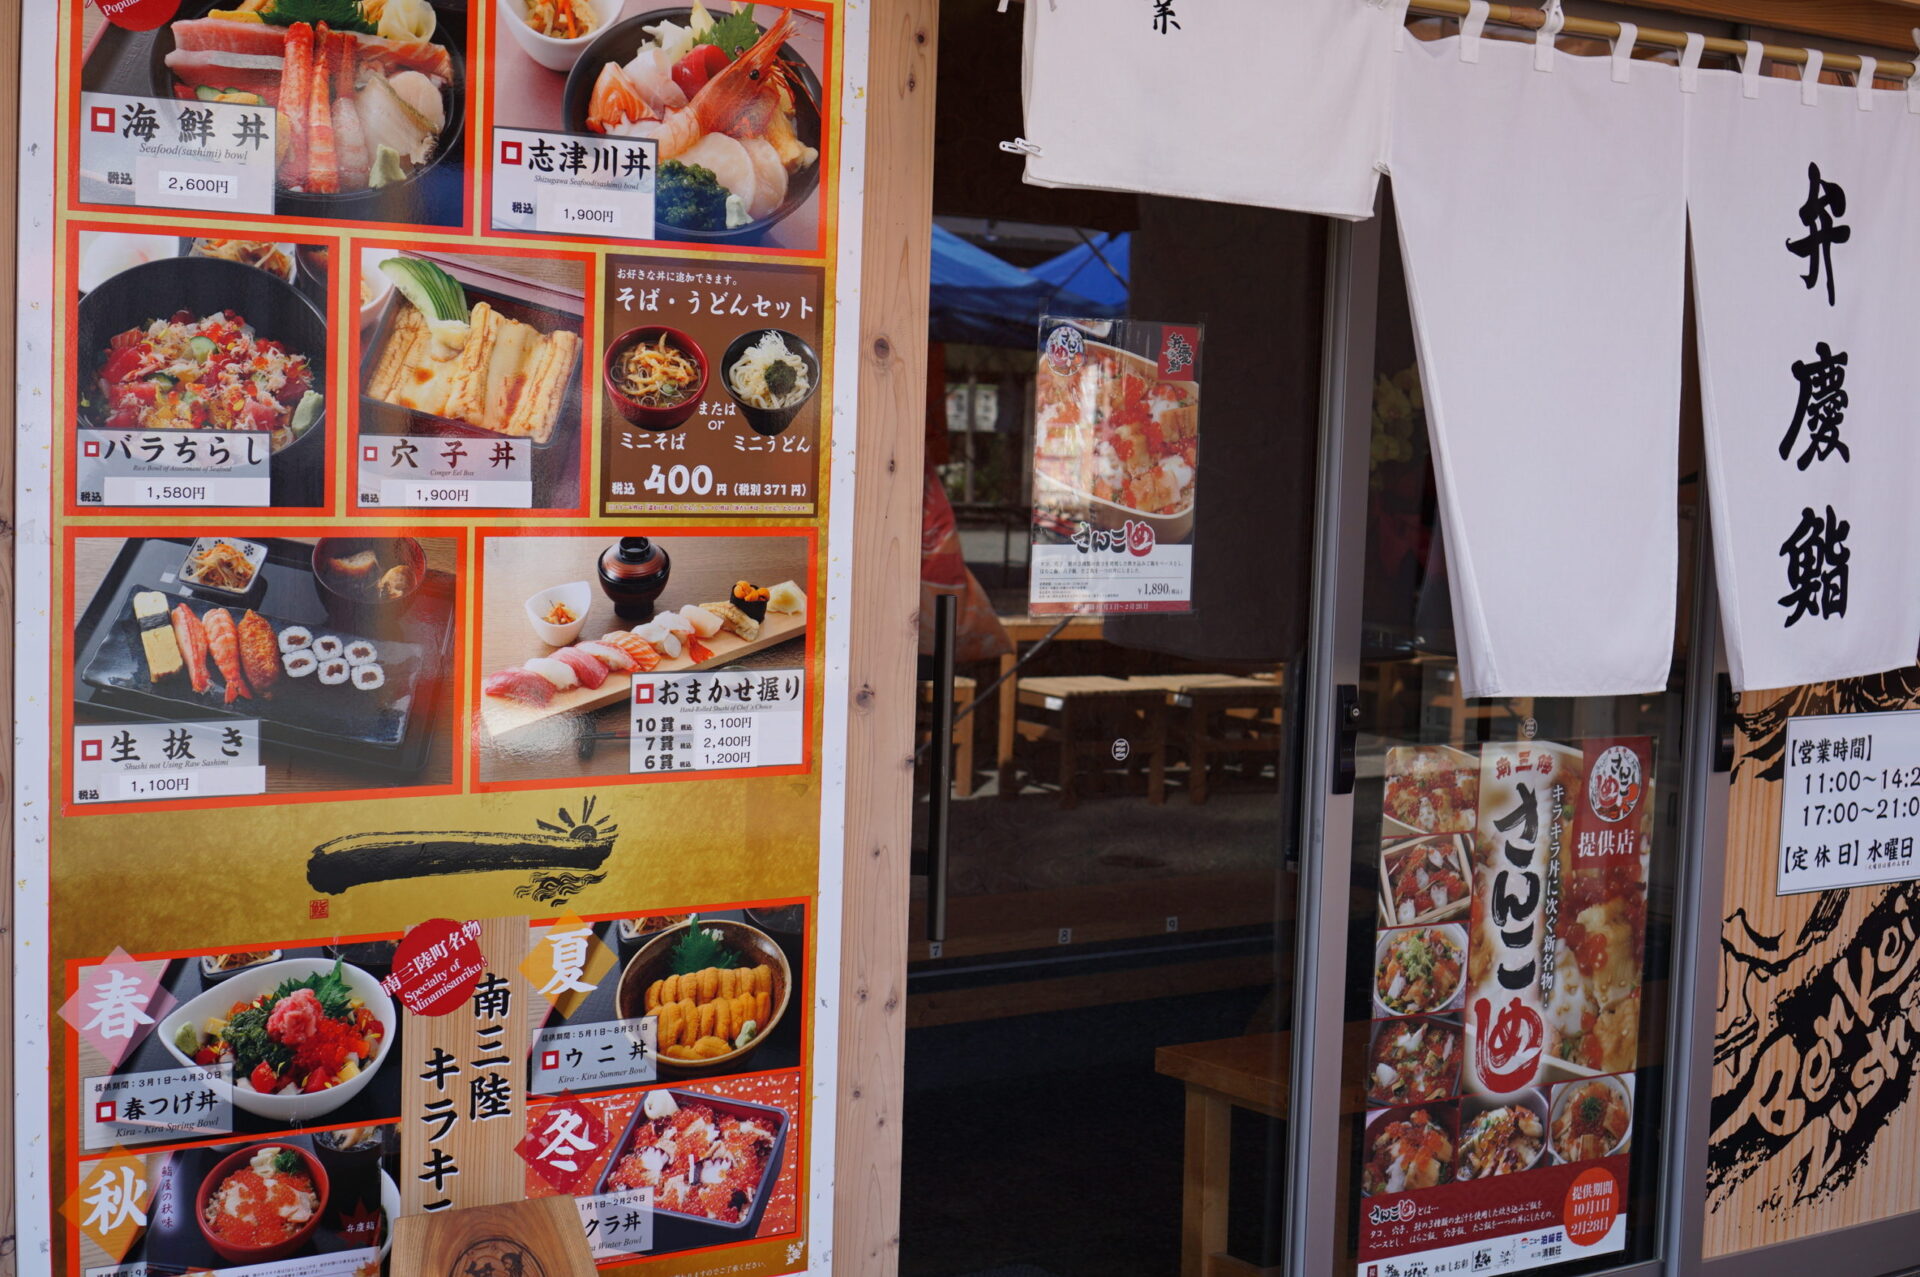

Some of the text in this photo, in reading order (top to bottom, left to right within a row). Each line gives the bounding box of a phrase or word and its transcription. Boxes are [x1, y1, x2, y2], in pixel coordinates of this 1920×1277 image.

[121, 102, 270, 151] 海鮮丼
[224, 149, 248, 160] bowl
[528, 138, 651, 180] 志津川丼
[108, 171, 229, 194] 税込 2,600円
[512, 201, 613, 223] 税込 1,900円
[616, 268, 738, 286] お好きな丼に追加できます。
[616, 287, 814, 320] そば・うどんセット
[698, 401, 737, 416] または
[1777, 161, 1851, 628] 弁慶鮨
[707, 419, 725, 431] or
[104, 434, 262, 465] バラちらし
[390, 438, 516, 470] 穴子丼
[620, 432, 687, 450] ミニそば
[733, 435, 811, 453] ミニうどん
[80, 486, 205, 503] 税込 1,580円
[361, 489, 469, 503] 税込 1,900円
[611, 482, 635, 495] 税込
[658, 675, 800, 705] おまかせ握り
[704, 716, 752, 730] 3,100円
[110, 726, 243, 763] 生抜き
[703, 735, 751, 748] 2,400円
[705, 751, 750, 765] 1,200円
[78, 777, 189, 801] 税込 1,100円
[1578, 829, 1635, 858] 提供店
[1866, 836, 1914, 863] 水曜日
[381, 920, 482, 996] 南三陸町名物
[537, 928, 598, 995] 夏
[404, 958, 461, 1003] Specialty of
[81, 969, 155, 1040] 春
[470, 973, 511, 1121] 南三陸
[566, 1039, 648, 1068] ウニ丼
[558, 1075, 574, 1084] Kira
[581, 1073, 597, 1081] Kira
[599, 1070, 628, 1079] Summer
[123, 1088, 219, 1121] 春つげ丼
[115, 1127, 136, 1138] Kira
[144, 1125, 164, 1135] Kira
[166, 1122, 195, 1133] Spring
[197, 1117, 219, 1128] Bowl
[418, 1048, 460, 1213] キラキ
[536, 1108, 598, 1172] 冬
[82, 1166, 147, 1236] 秋
